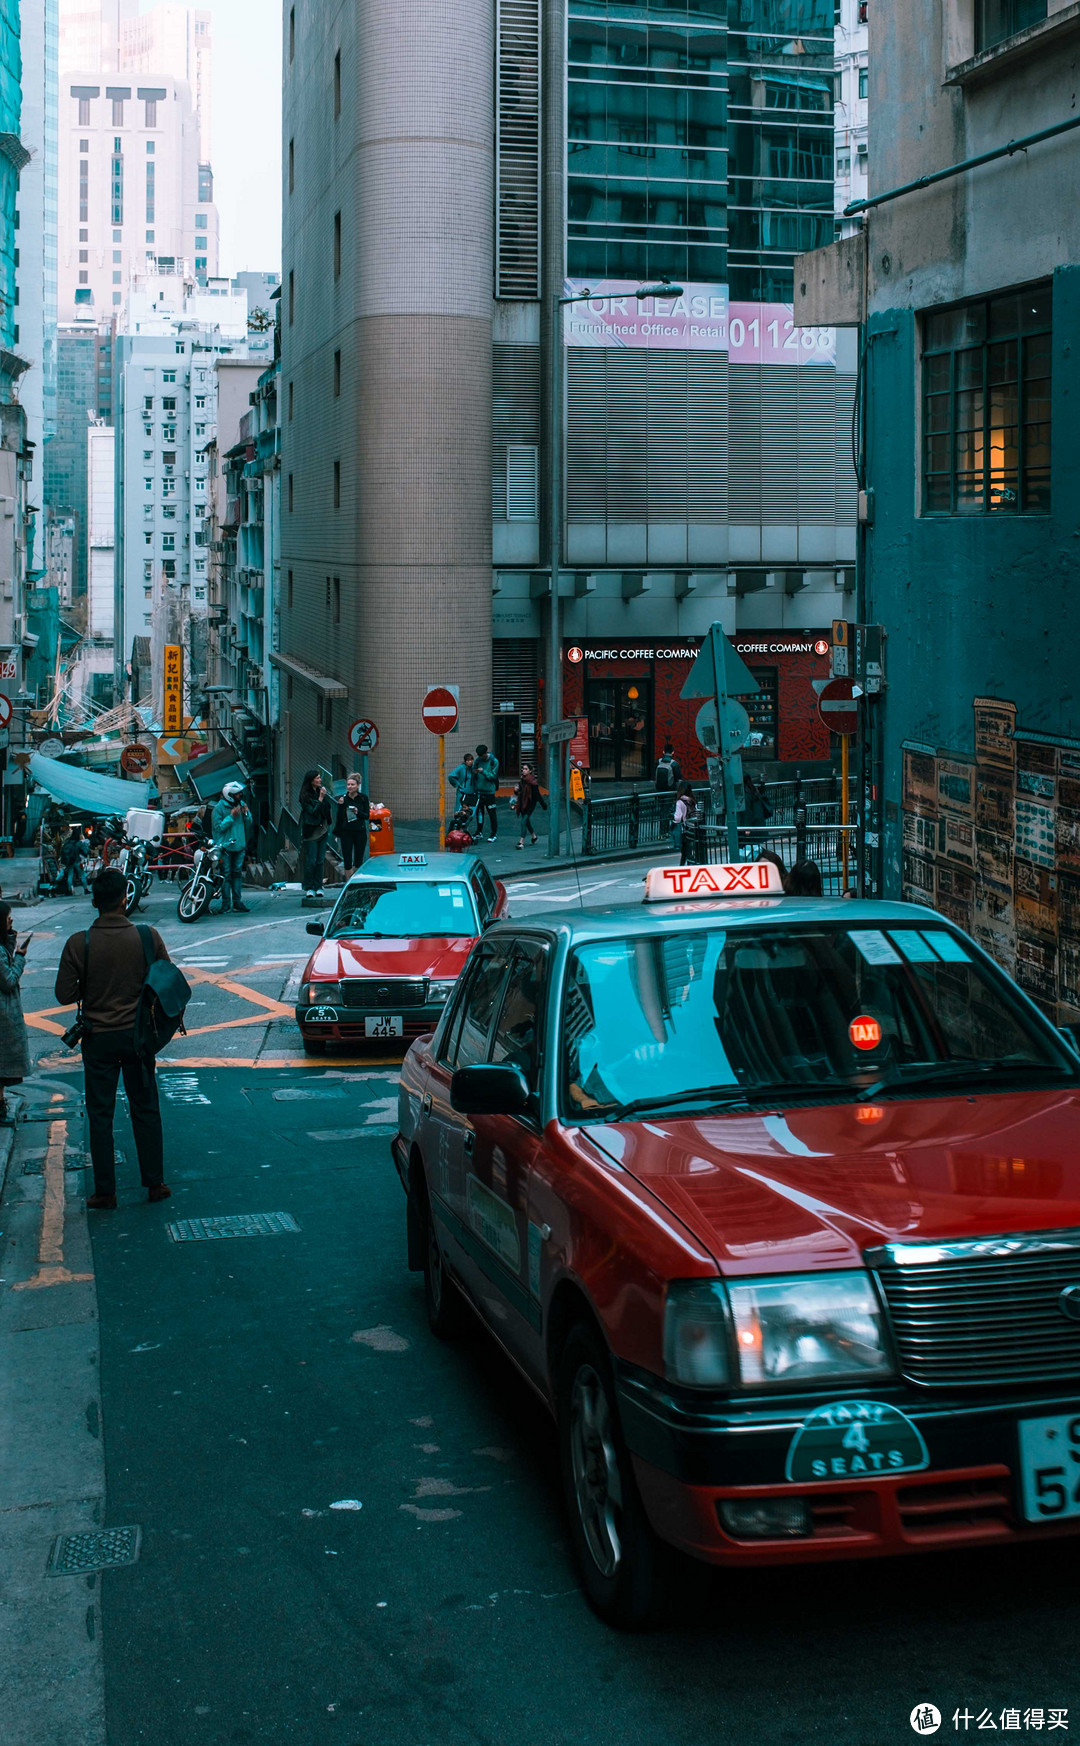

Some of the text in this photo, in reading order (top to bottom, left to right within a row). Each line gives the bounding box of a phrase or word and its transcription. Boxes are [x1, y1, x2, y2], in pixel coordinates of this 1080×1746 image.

[570, 292, 726, 319] FOR LEASE
[570, 322, 637, 336] Furnished
[641, 323, 679, 336] Office
[690, 325, 726, 337] Retail
[584, 650, 618, 659] PACIFIC
[619, 649, 654, 659] COFFEE
[737, 643, 813, 652] COFFEE COMPANY
[401, 855, 424, 863] TAXI
[663, 865, 769, 893] TAXI
[375, 1017, 391, 1027] JW
[372, 1027, 396, 1037] 445
[850, 1023, 880, 1041] TAXI
[841, 1419, 870, 1453] 4
[811, 1450, 904, 1477] SEATS
